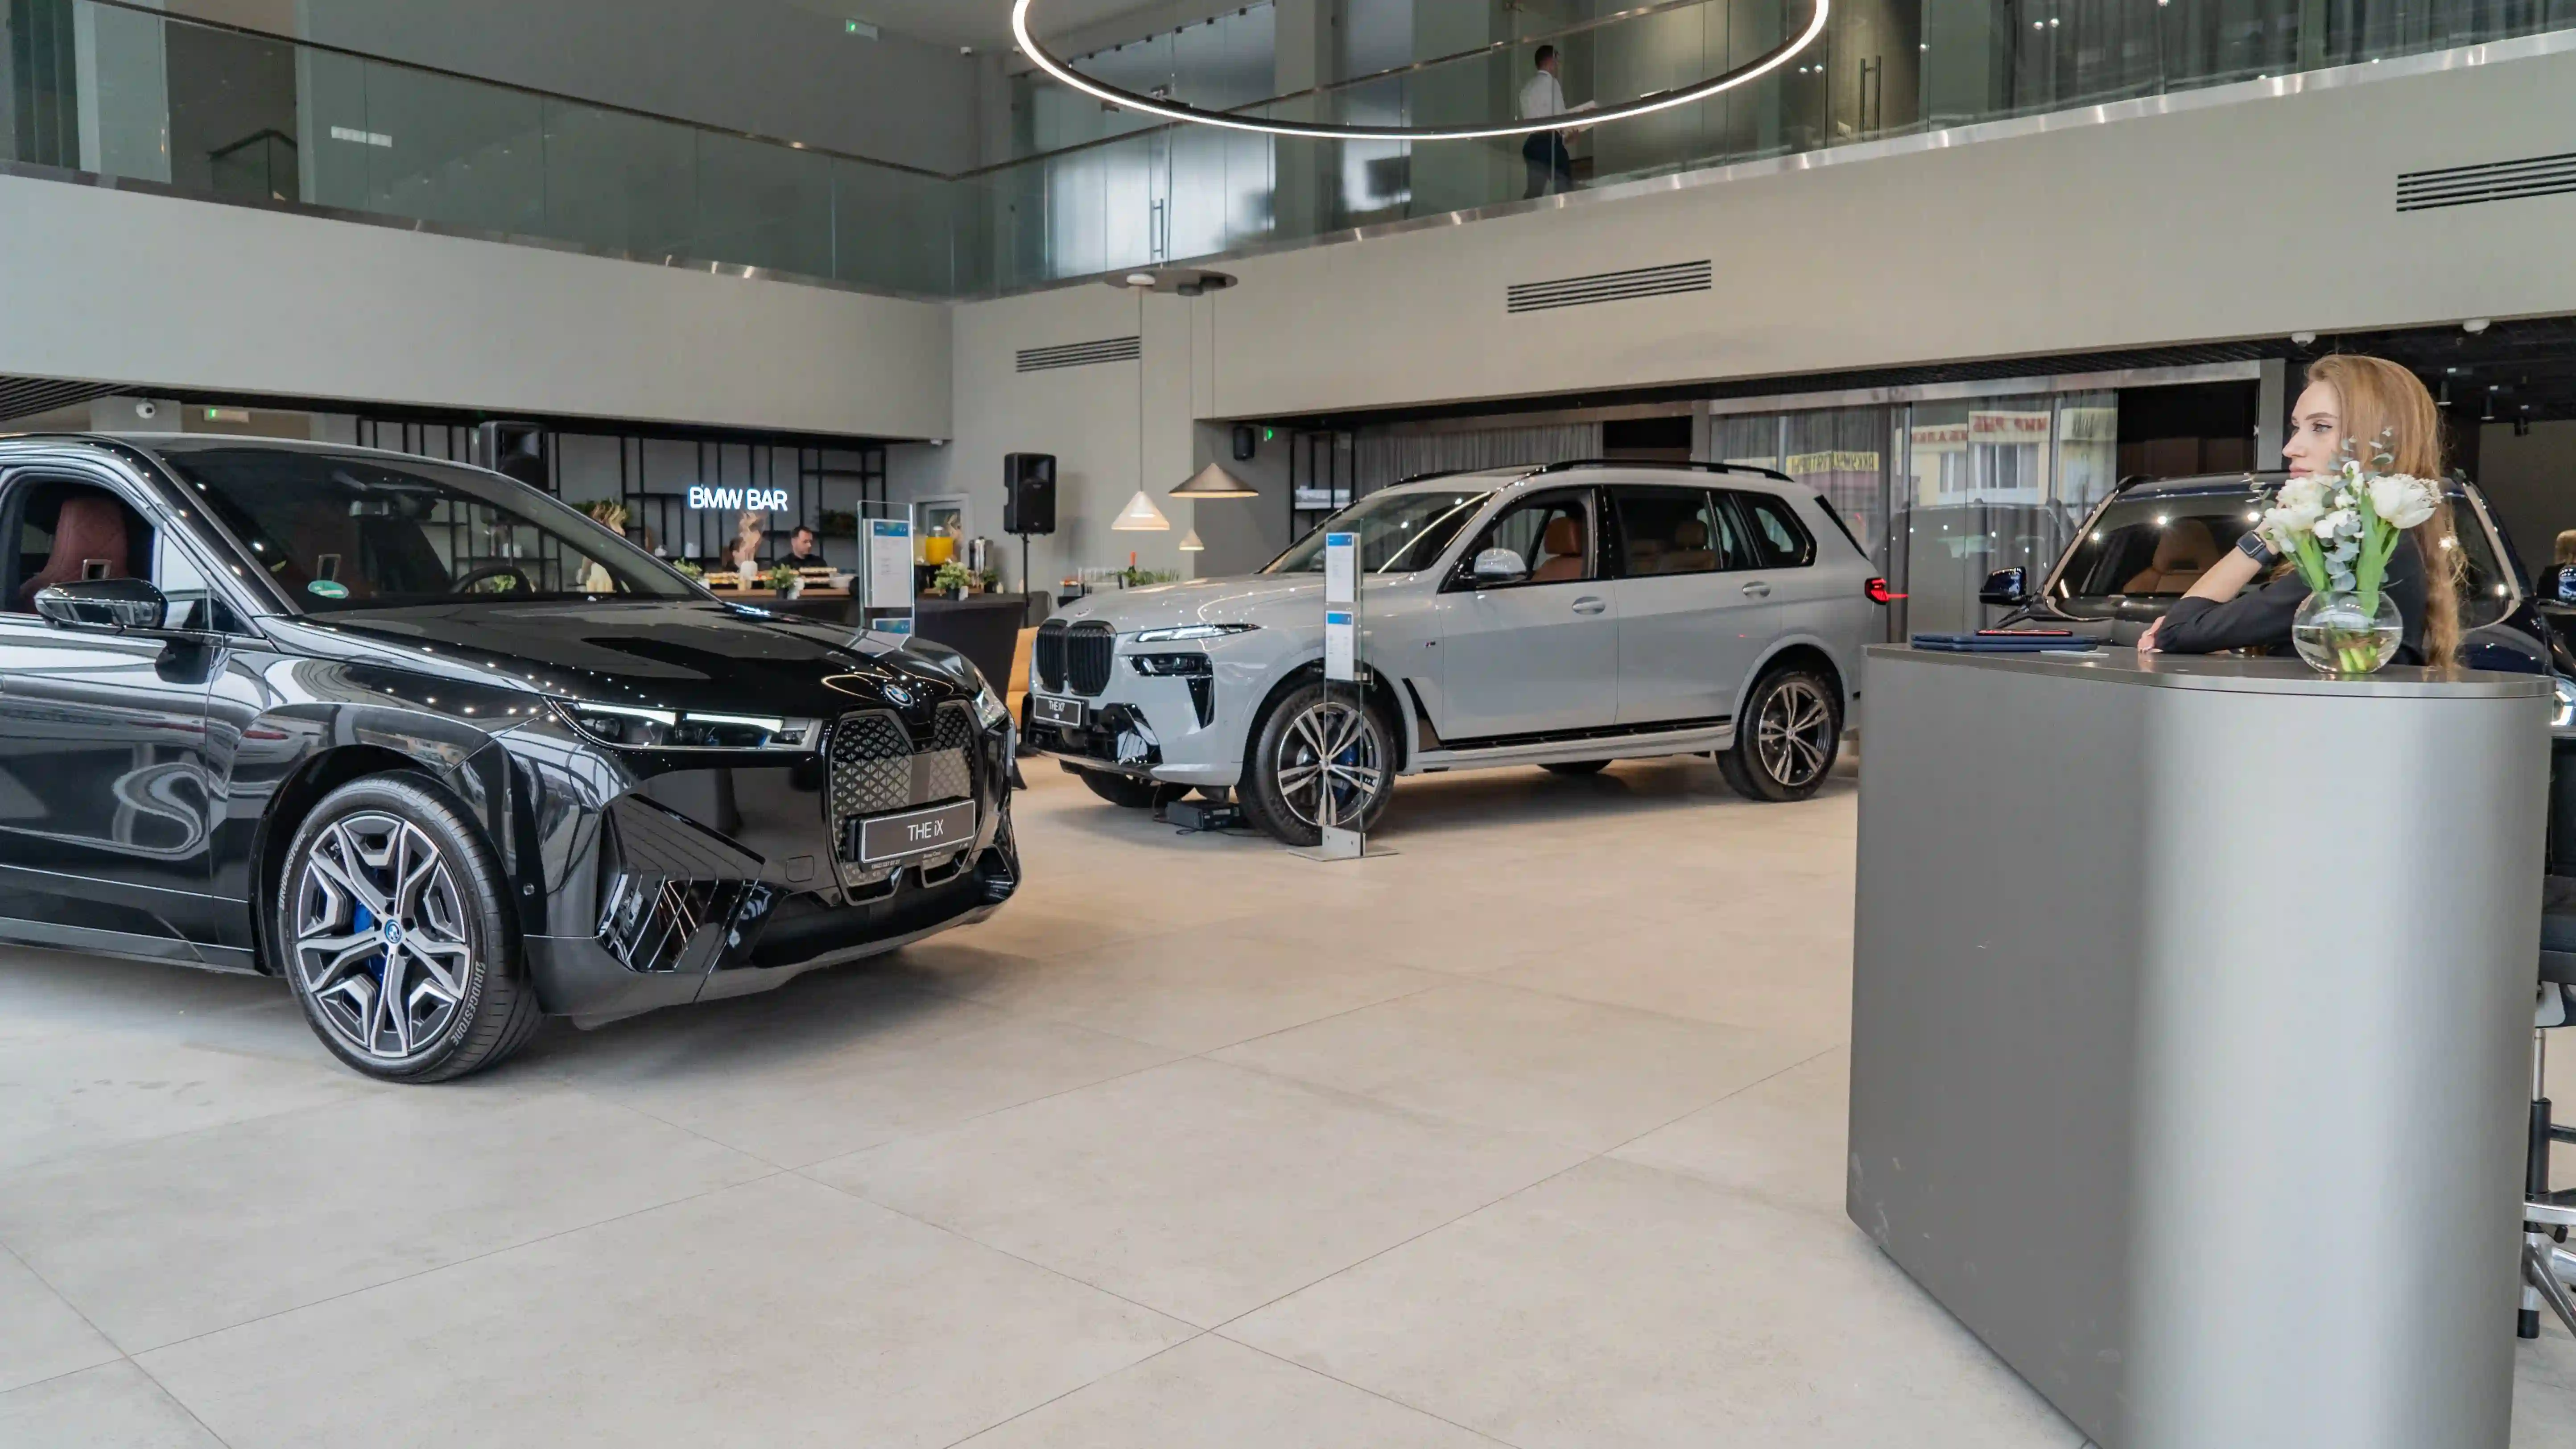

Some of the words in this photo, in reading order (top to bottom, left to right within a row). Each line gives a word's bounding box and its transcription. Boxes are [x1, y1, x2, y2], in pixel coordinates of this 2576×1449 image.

[689, 486, 743, 509] BMW
[747, 489, 788, 511] BAR
[907, 822, 932, 842] THE
[934, 818, 944, 837] iX
[450, 959, 486, 1046] BRIDGESTONE
